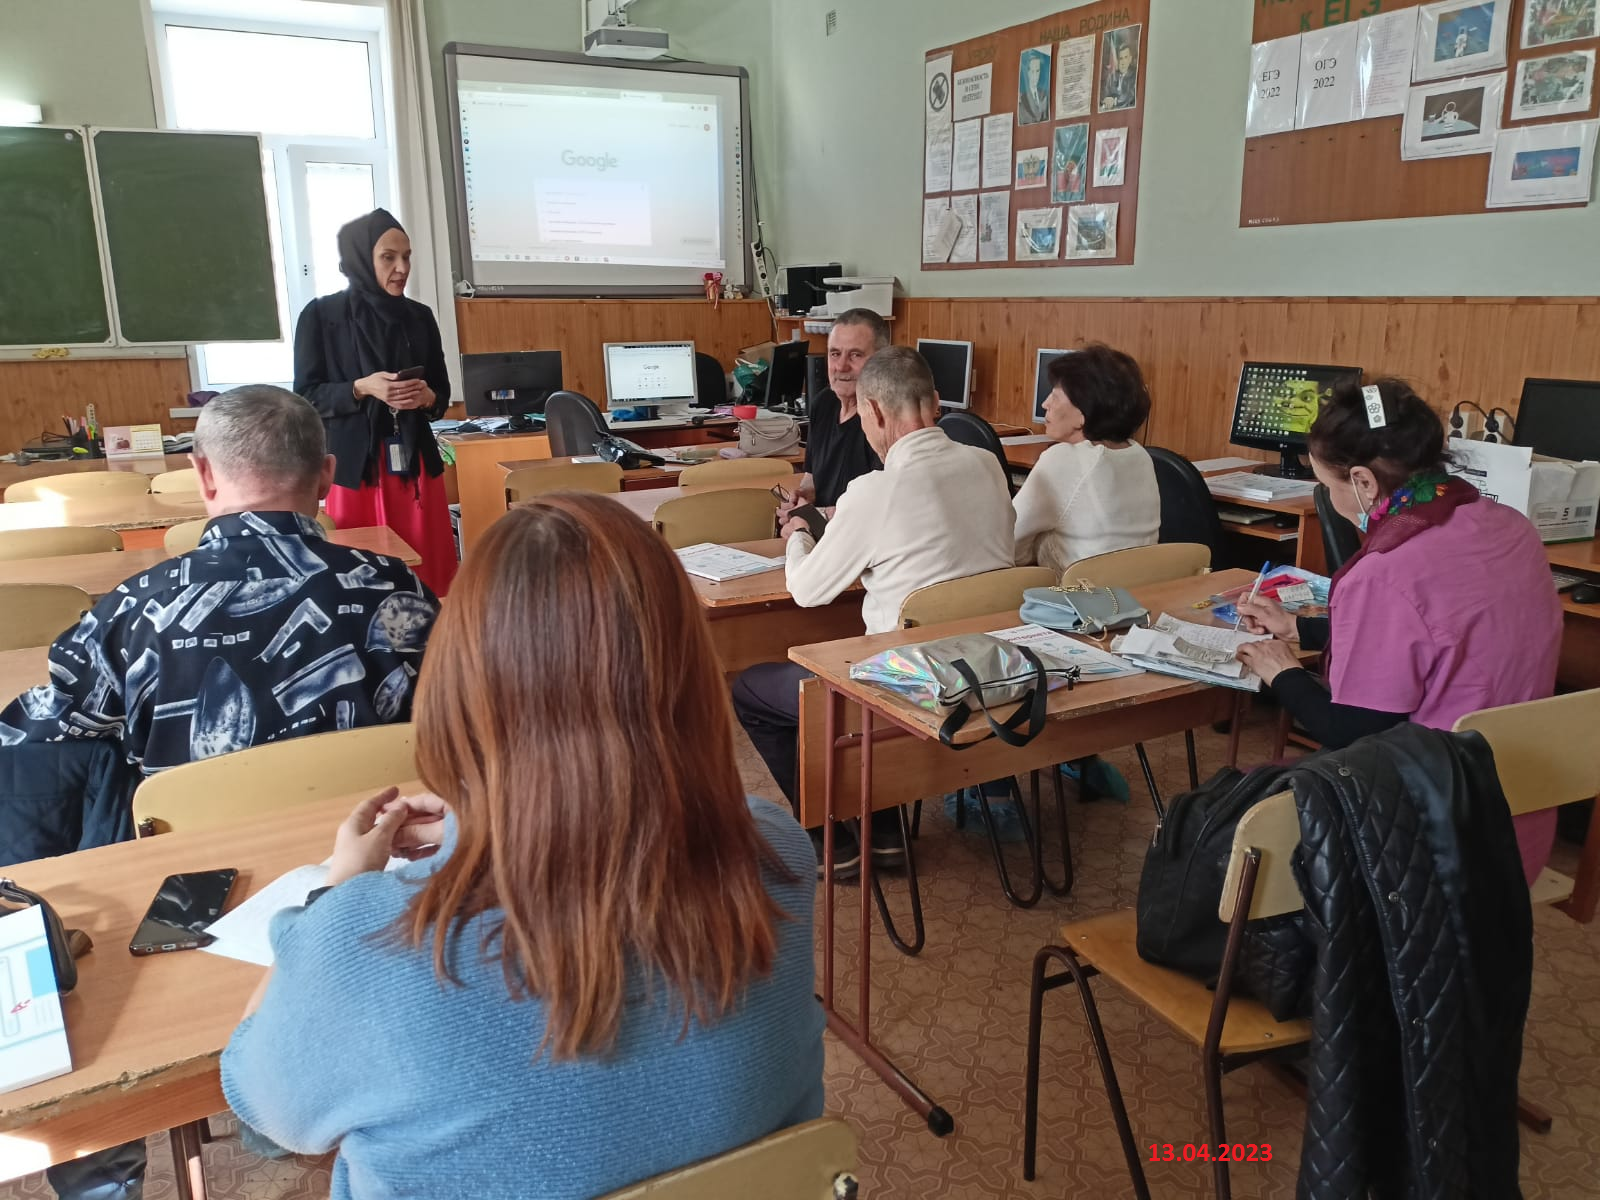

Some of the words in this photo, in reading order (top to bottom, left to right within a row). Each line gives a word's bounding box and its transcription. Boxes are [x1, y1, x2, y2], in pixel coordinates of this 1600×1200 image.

[1040, 24, 1071, 44] НАША
[1080, 7, 1130, 34] РОДИНА
[1315, 57, 1337, 71] ОГЭ
[1262, 69, 1280, 82] ЕГЭ
[1313, 75, 1335, 89] 2022
[1261, 86, 1281, 99] 2022
[561, 149, 618, 171] Google
